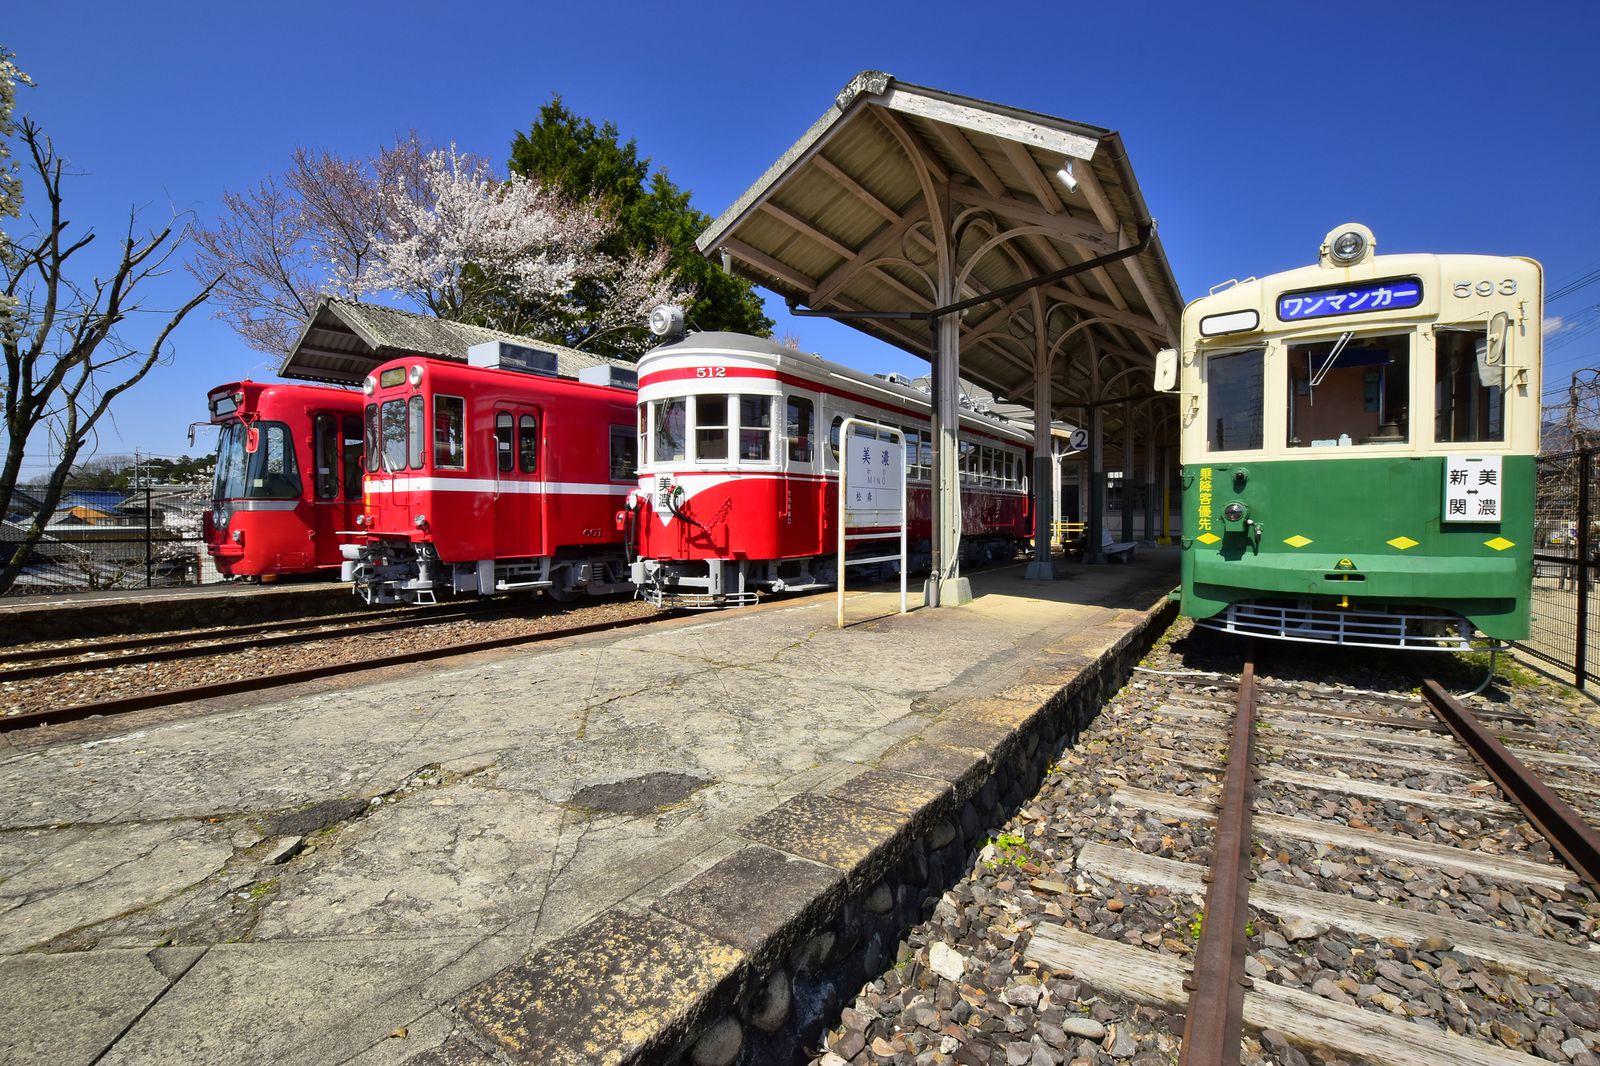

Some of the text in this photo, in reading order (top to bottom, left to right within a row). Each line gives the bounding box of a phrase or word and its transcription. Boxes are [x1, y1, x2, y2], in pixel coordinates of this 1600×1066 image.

[1453, 279, 1518, 298] 593
[1284, 287, 1417, 316] ワンマンカー
[696, 367, 726, 378] 512
[1075, 431, 1087, 448] 2
[862, 447, 889, 466] 美濃
[867, 476, 886, 485] MINO
